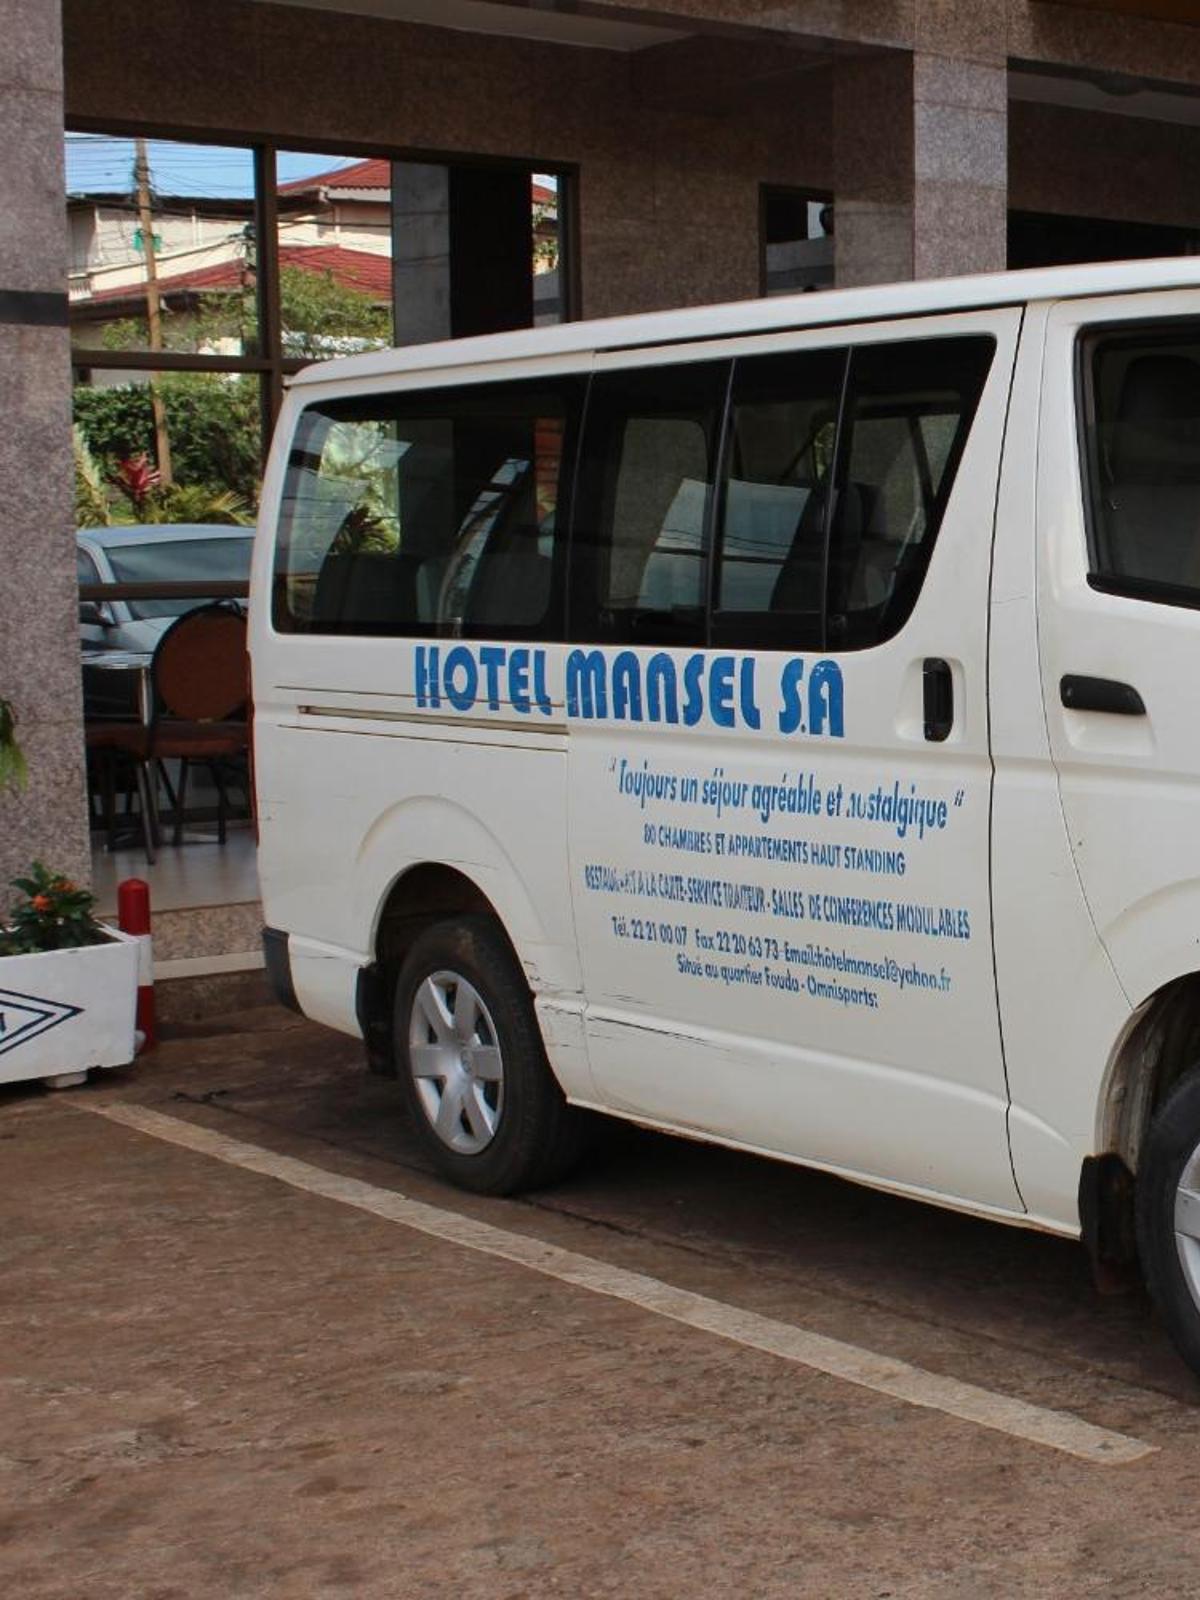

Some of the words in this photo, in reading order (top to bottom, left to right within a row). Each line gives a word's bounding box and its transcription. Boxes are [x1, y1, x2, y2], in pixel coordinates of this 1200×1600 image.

[415, 646, 552, 716] HOTEL
[566, 649, 761, 730] MANSEL
[680, 773, 699, 802] un
[702, 768, 748, 818] séjour
[752, 773, 821, 823] agréable
[827, 783, 844, 816] et
[659, 825, 713, 854] CHAMBRES
[715, 832, 726, 855] ET
[728, 834, 808, 864] APPARTEMENTS
[811, 843, 841, 868] HAUT
[844, 846, 906, 876] STANDING
[631, 919, 645, 941] 22
[645, 921, 657, 941] 21
[659, 923, 673, 944] 00
[675, 926, 687, 945] 07
[695, 928, 715, 950] Fax
[716, 931, 731, 953] 22
[732, 934, 747, 955] 20
[748, 936, 762, 958] 63
[772, 888, 804, 919] SALLES
[808, 894, 822, 920] DE
[823, 895, 894, 931] CONFERENCES
[896, 903, 970, 940] MODULABLES
[705, 964, 719, 979] au
[721, 963, 762, 986] quartier
